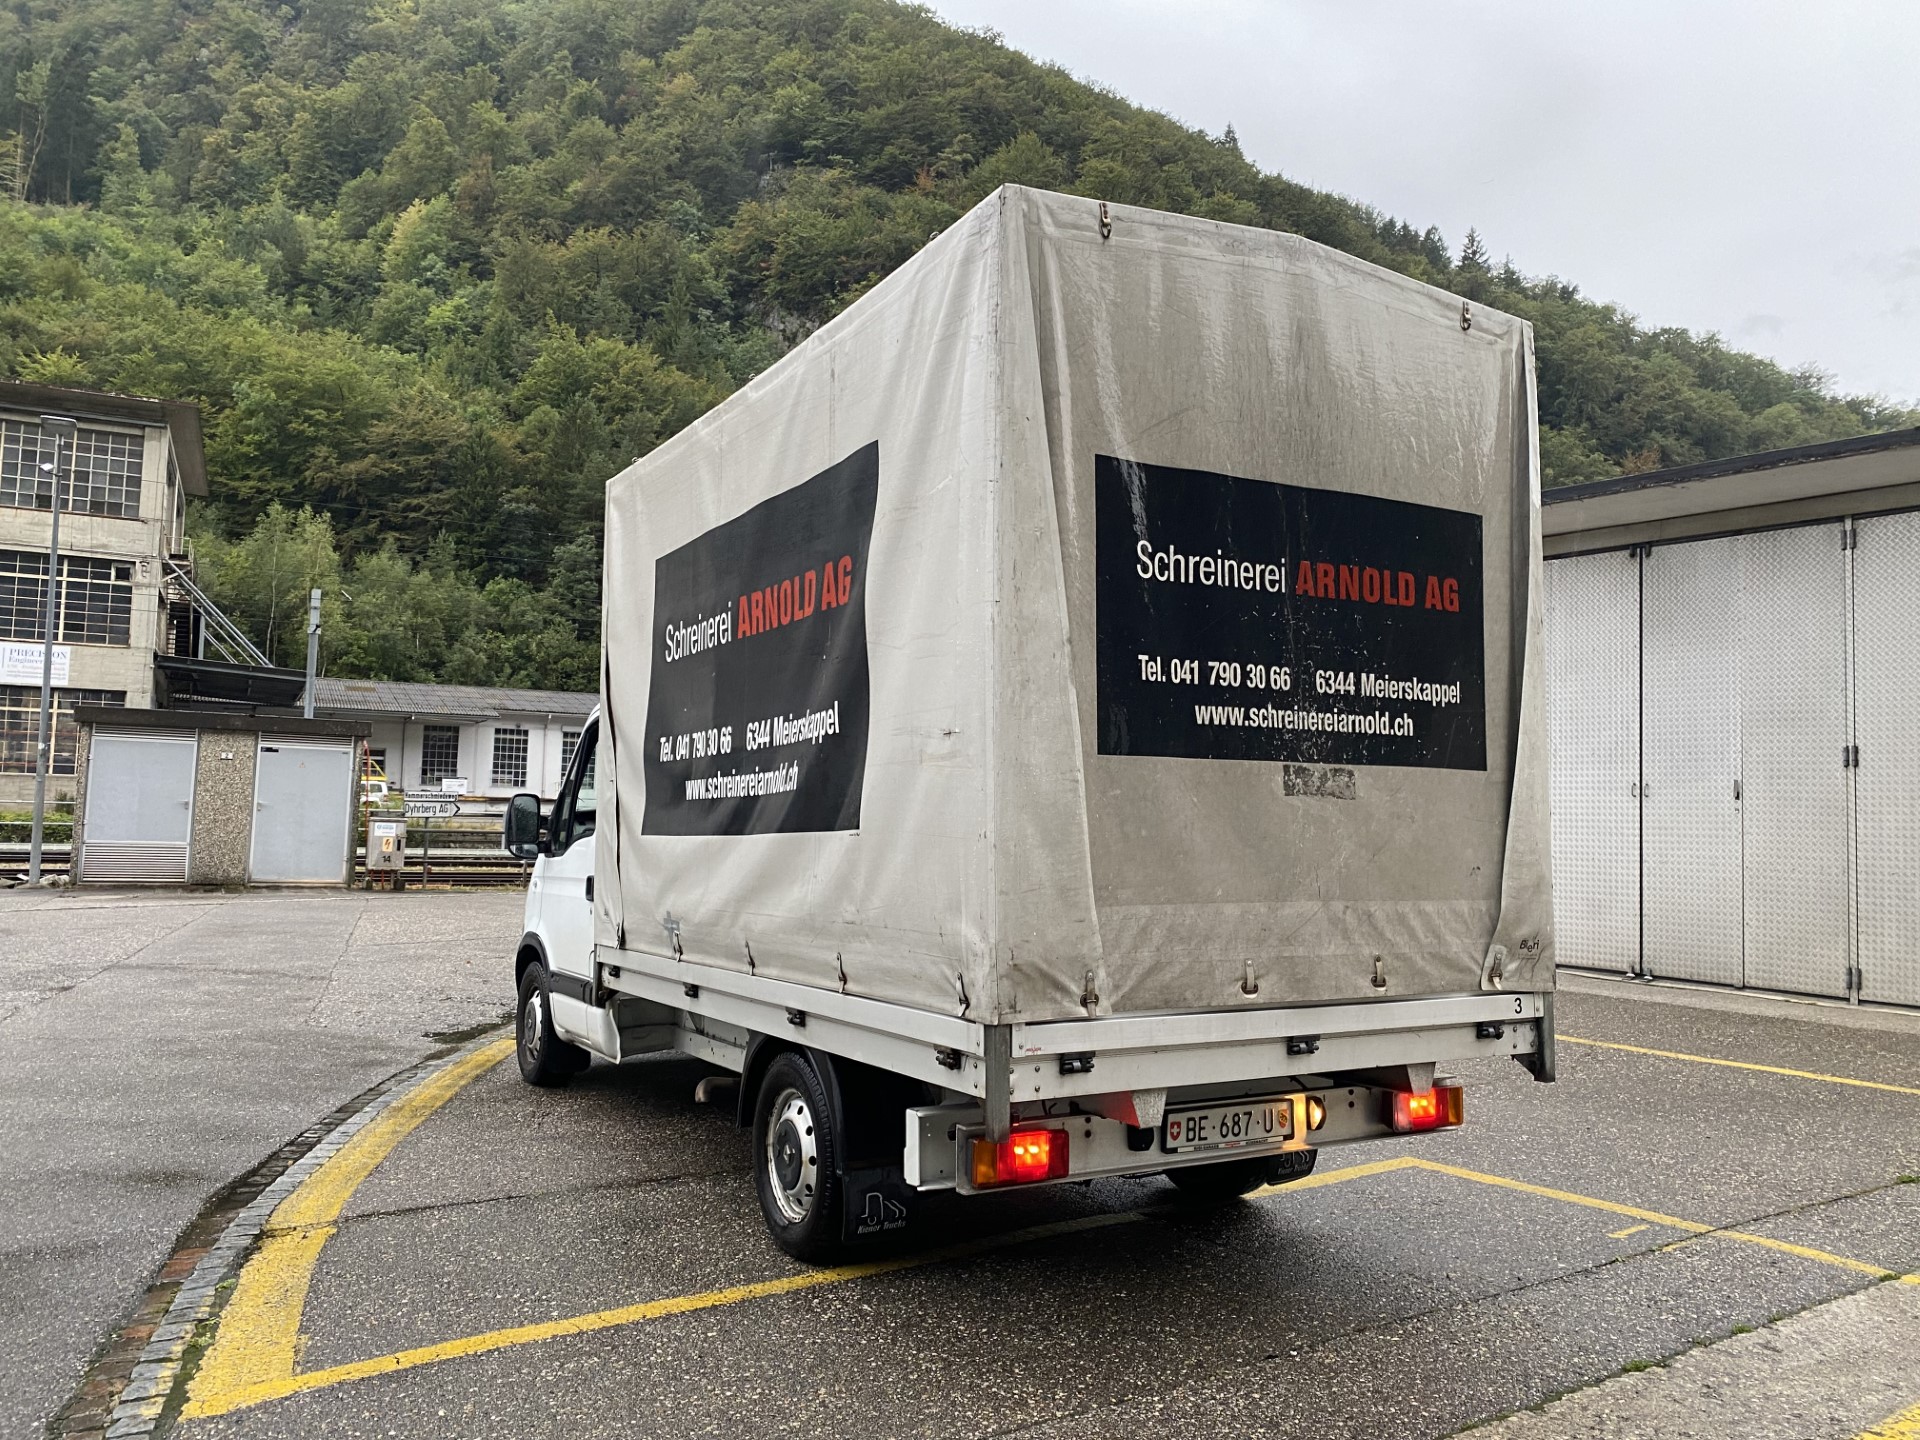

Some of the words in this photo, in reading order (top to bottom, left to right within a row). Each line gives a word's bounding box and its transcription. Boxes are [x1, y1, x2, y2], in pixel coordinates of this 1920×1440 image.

[1137, 540, 1286, 593] Schreinerei
[1296, 560, 1415, 606] ARNOLD
[1424, 575, 1460, 613] AG
[665, 601, 732, 663] Schreinerei
[737, 569, 817, 639] ARNOLD
[821, 555, 853, 611] AG
[10, 648, 67, 659] PRECION
[1138, 654, 1167, 683] Tel.
[1170, 658, 1199, 685] 041
[1207, 661, 1242, 688] 790
[1246, 663, 1267, 690] 30
[1269, 665, 1292, 691] 66
[1315, 669, 1356, 696] 6344
[1360, 672, 1460, 708] Meierskappel
[659, 736, 674, 763] Tel.
[675, 733, 690, 761] 041
[692, 731, 706, 759] 790
[707, 728, 718, 756] 30
[719, 725, 733, 755] 66
[746, 718, 771, 751] 6344
[772, 700, 840, 746] Meierskappel
[1194, 701, 1414, 737] www.schreinereiarnold.ch
[685, 760, 799, 801] www.schreinereiarnold.ch
[405, 803, 437, 816] Dyhrberg
[438, 803, 449, 813] AG
[382, 855, 391, 863] 14
[1514, 997, 1523, 1014] 3
[883, 1219, 906, 1230] Trucks
